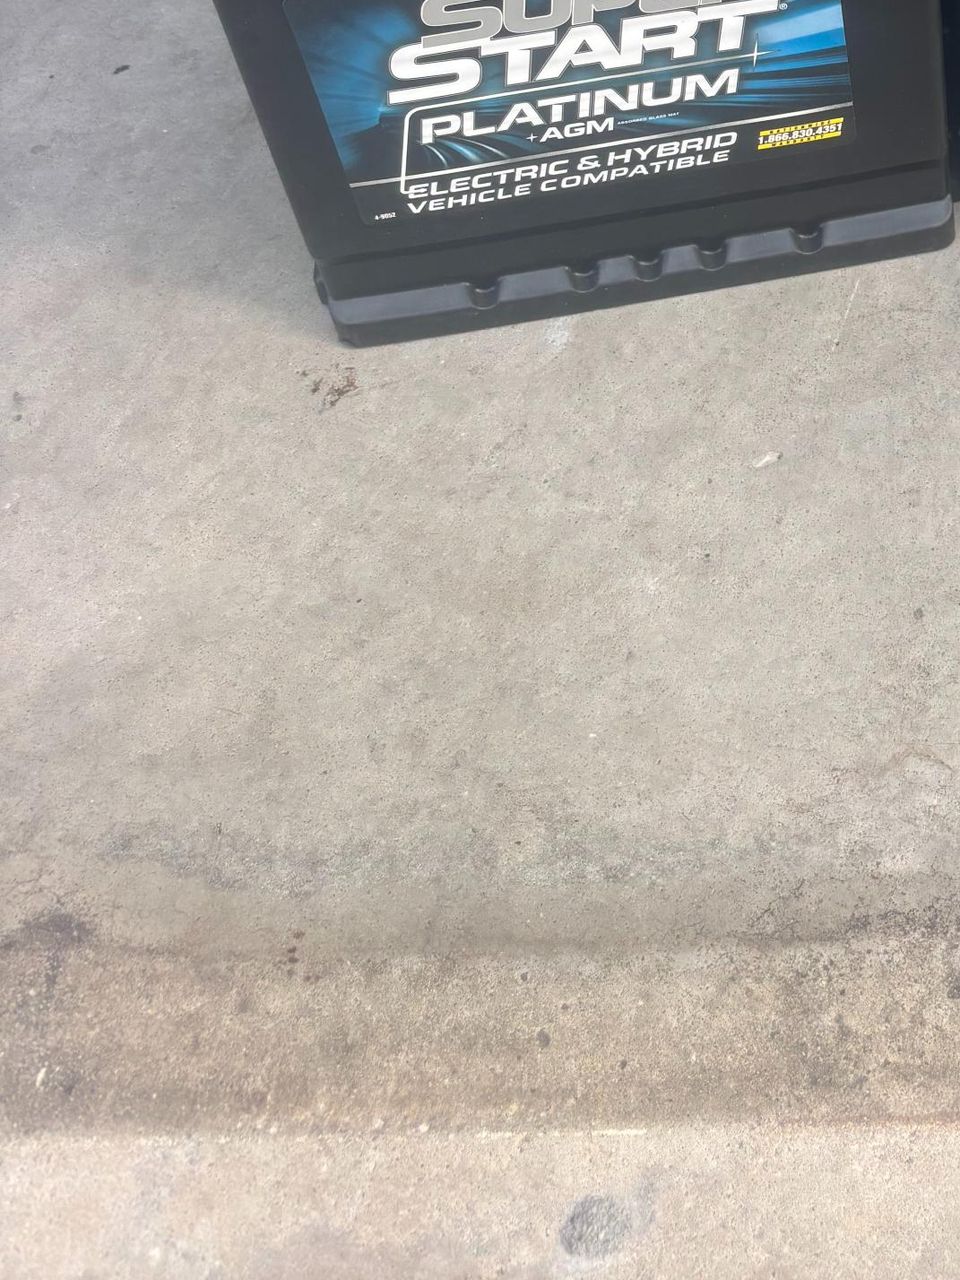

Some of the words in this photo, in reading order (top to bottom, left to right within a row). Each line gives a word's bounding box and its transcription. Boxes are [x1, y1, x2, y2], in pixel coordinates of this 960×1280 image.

[420, 67, 740, 146] PLATINUM
[539, 117, 615, 143] AGM
[758, 123, 843, 145] 1.866.830.4351
[407, 183, 531, 214] VEHICLE
[540, 148, 731, 192] COMPATIBLE
[408, 158, 568, 199] ELECTRIC
[576, 154, 600, 171] &
[607, 131, 738, 166] HYBRID
